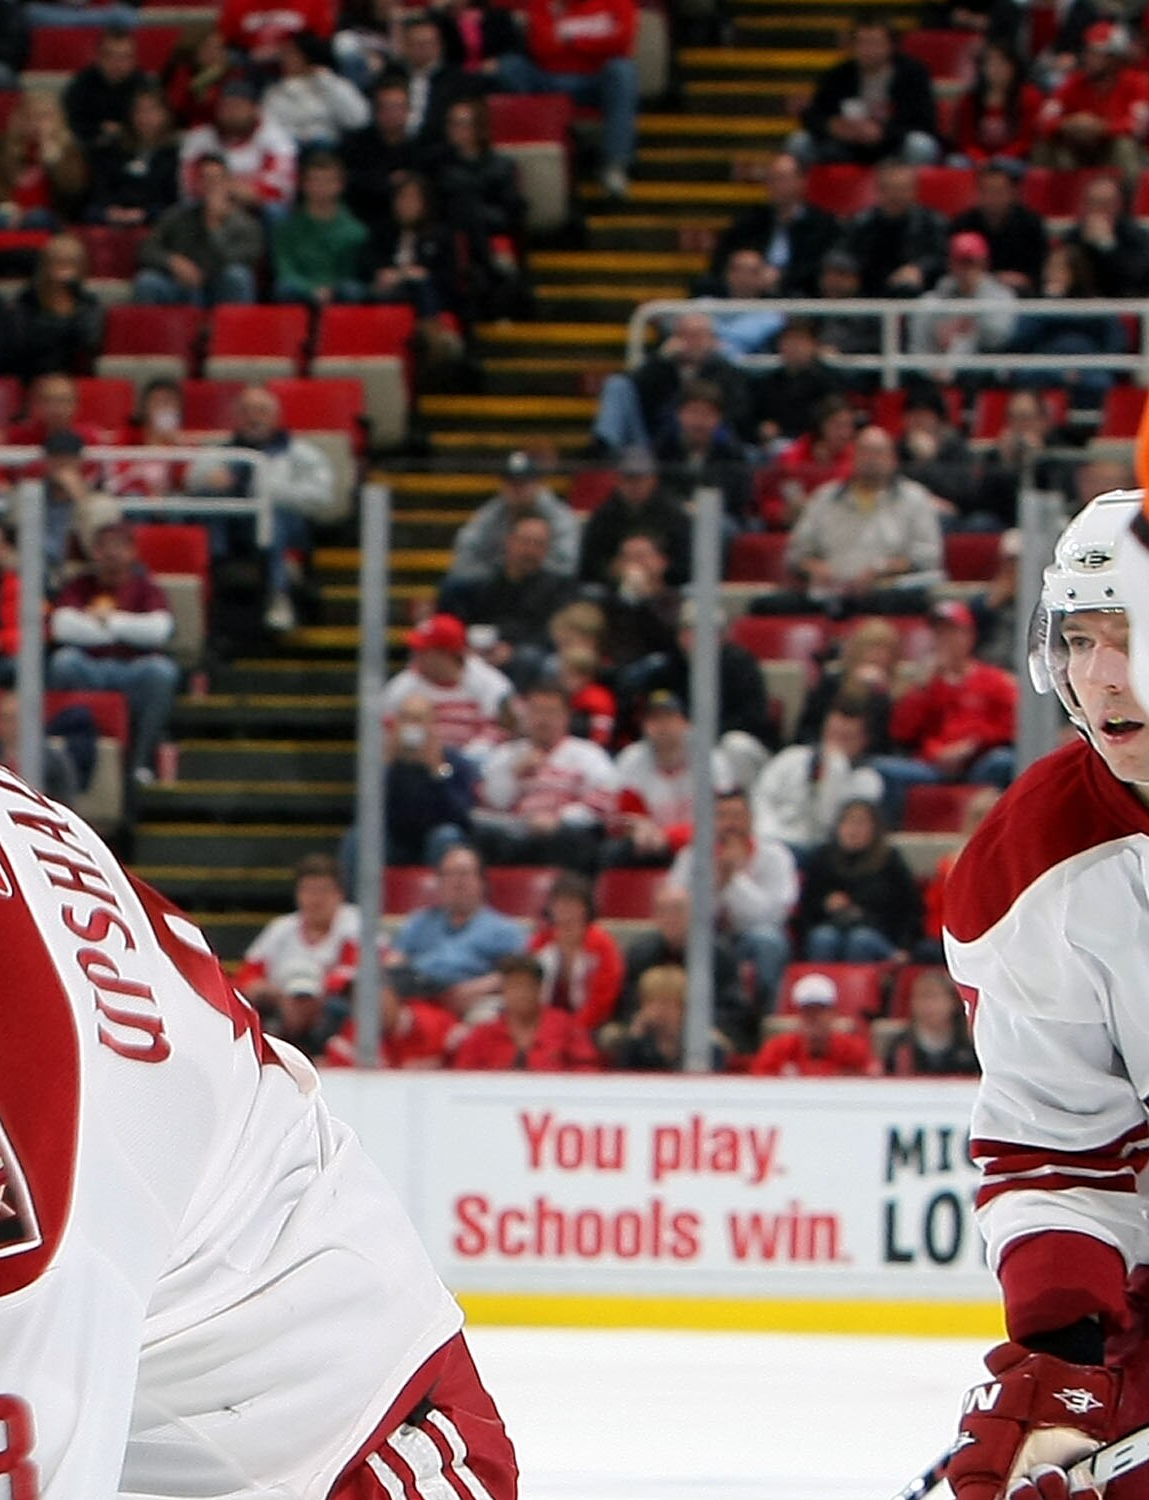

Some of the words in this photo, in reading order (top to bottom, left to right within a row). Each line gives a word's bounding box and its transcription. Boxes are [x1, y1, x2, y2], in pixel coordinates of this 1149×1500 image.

[519, 1111, 627, 1171] You
[651, 1114, 787, 1184] play.
[454, 1196, 701, 1259] Schools
[727, 1201, 850, 1263] win.
[885, 1190, 976, 1264] LO
